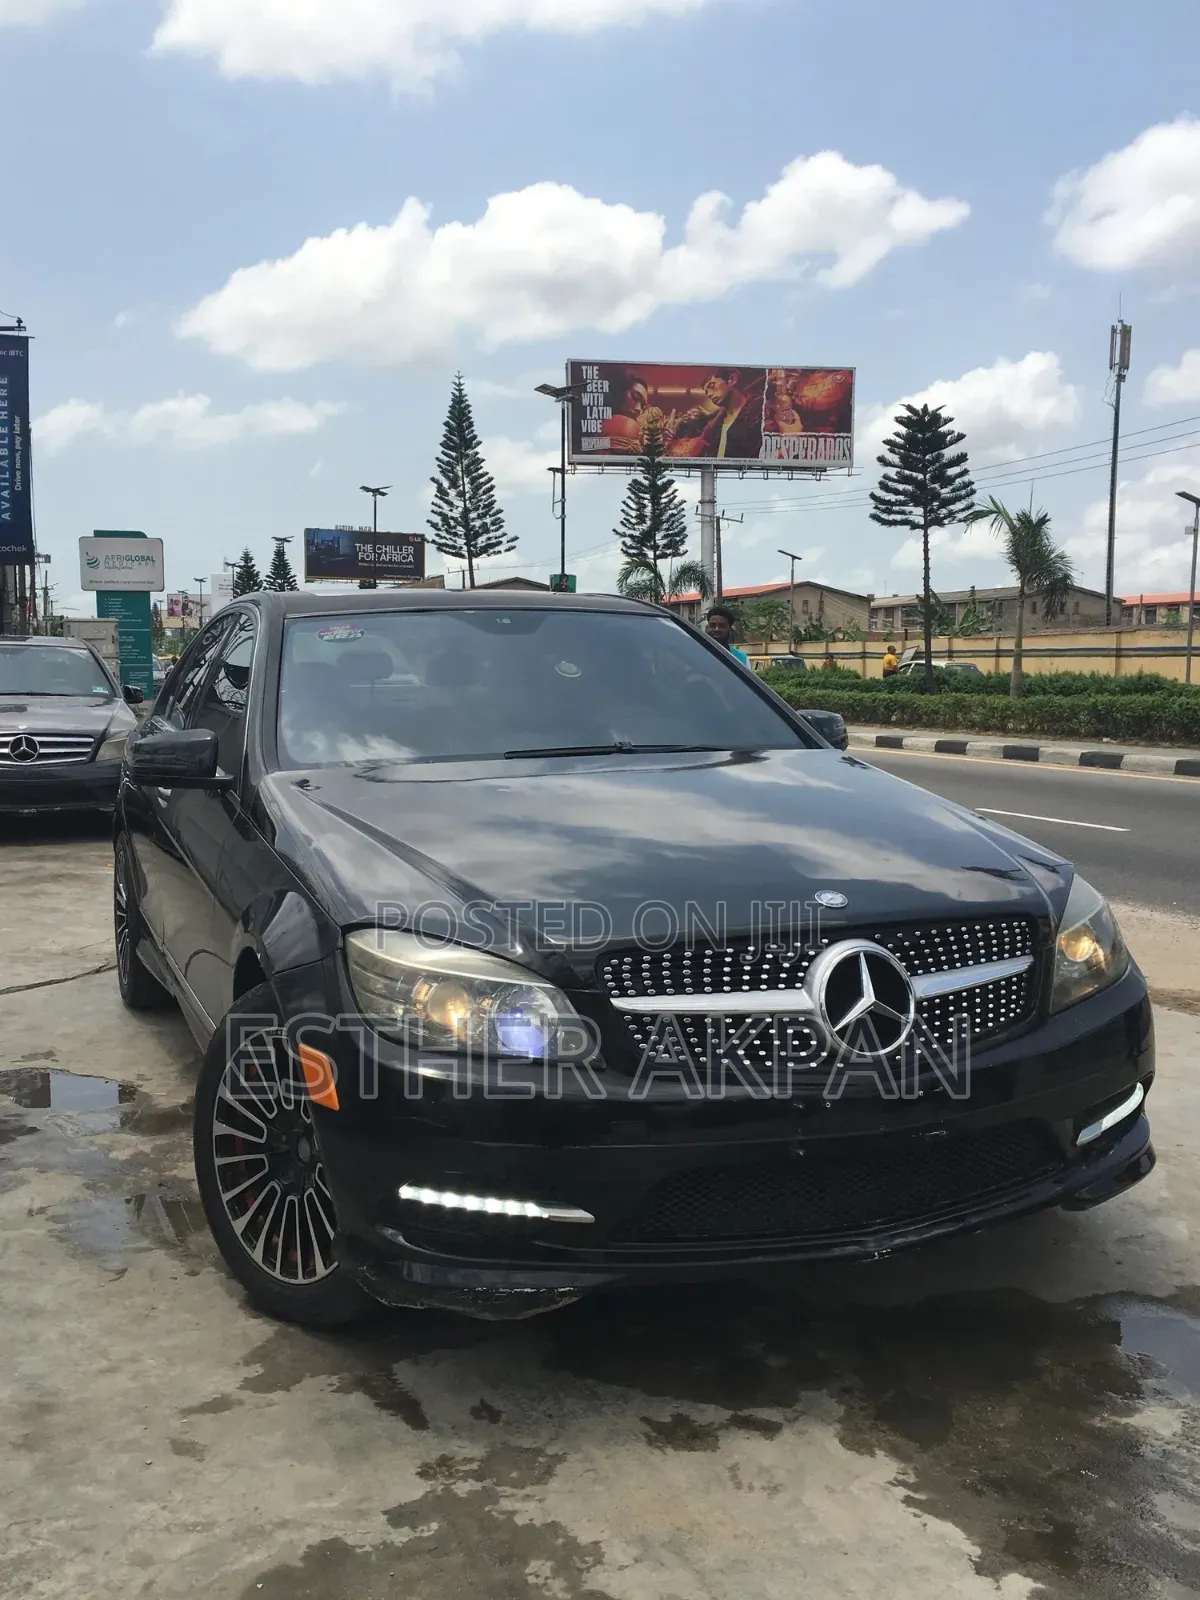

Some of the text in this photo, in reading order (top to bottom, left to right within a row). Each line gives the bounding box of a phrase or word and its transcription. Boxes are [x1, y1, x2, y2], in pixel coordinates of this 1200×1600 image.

[581, 365, 599, 380] THE
[586, 380, 610, 392] BEER
[581, 392, 604, 406] WITH
[586, 406, 612, 420] LATIN
[581, 420, 602, 433] VIBE
[761, 436, 852, 460] DESPERADOS
[0, 426, 10, 520] AVAILABLE
[355, 544, 414, 554] THE CHILLER
[104, 554, 155, 562] AFRIGLOBAL
[380, 554, 414, 563] AFRICA
